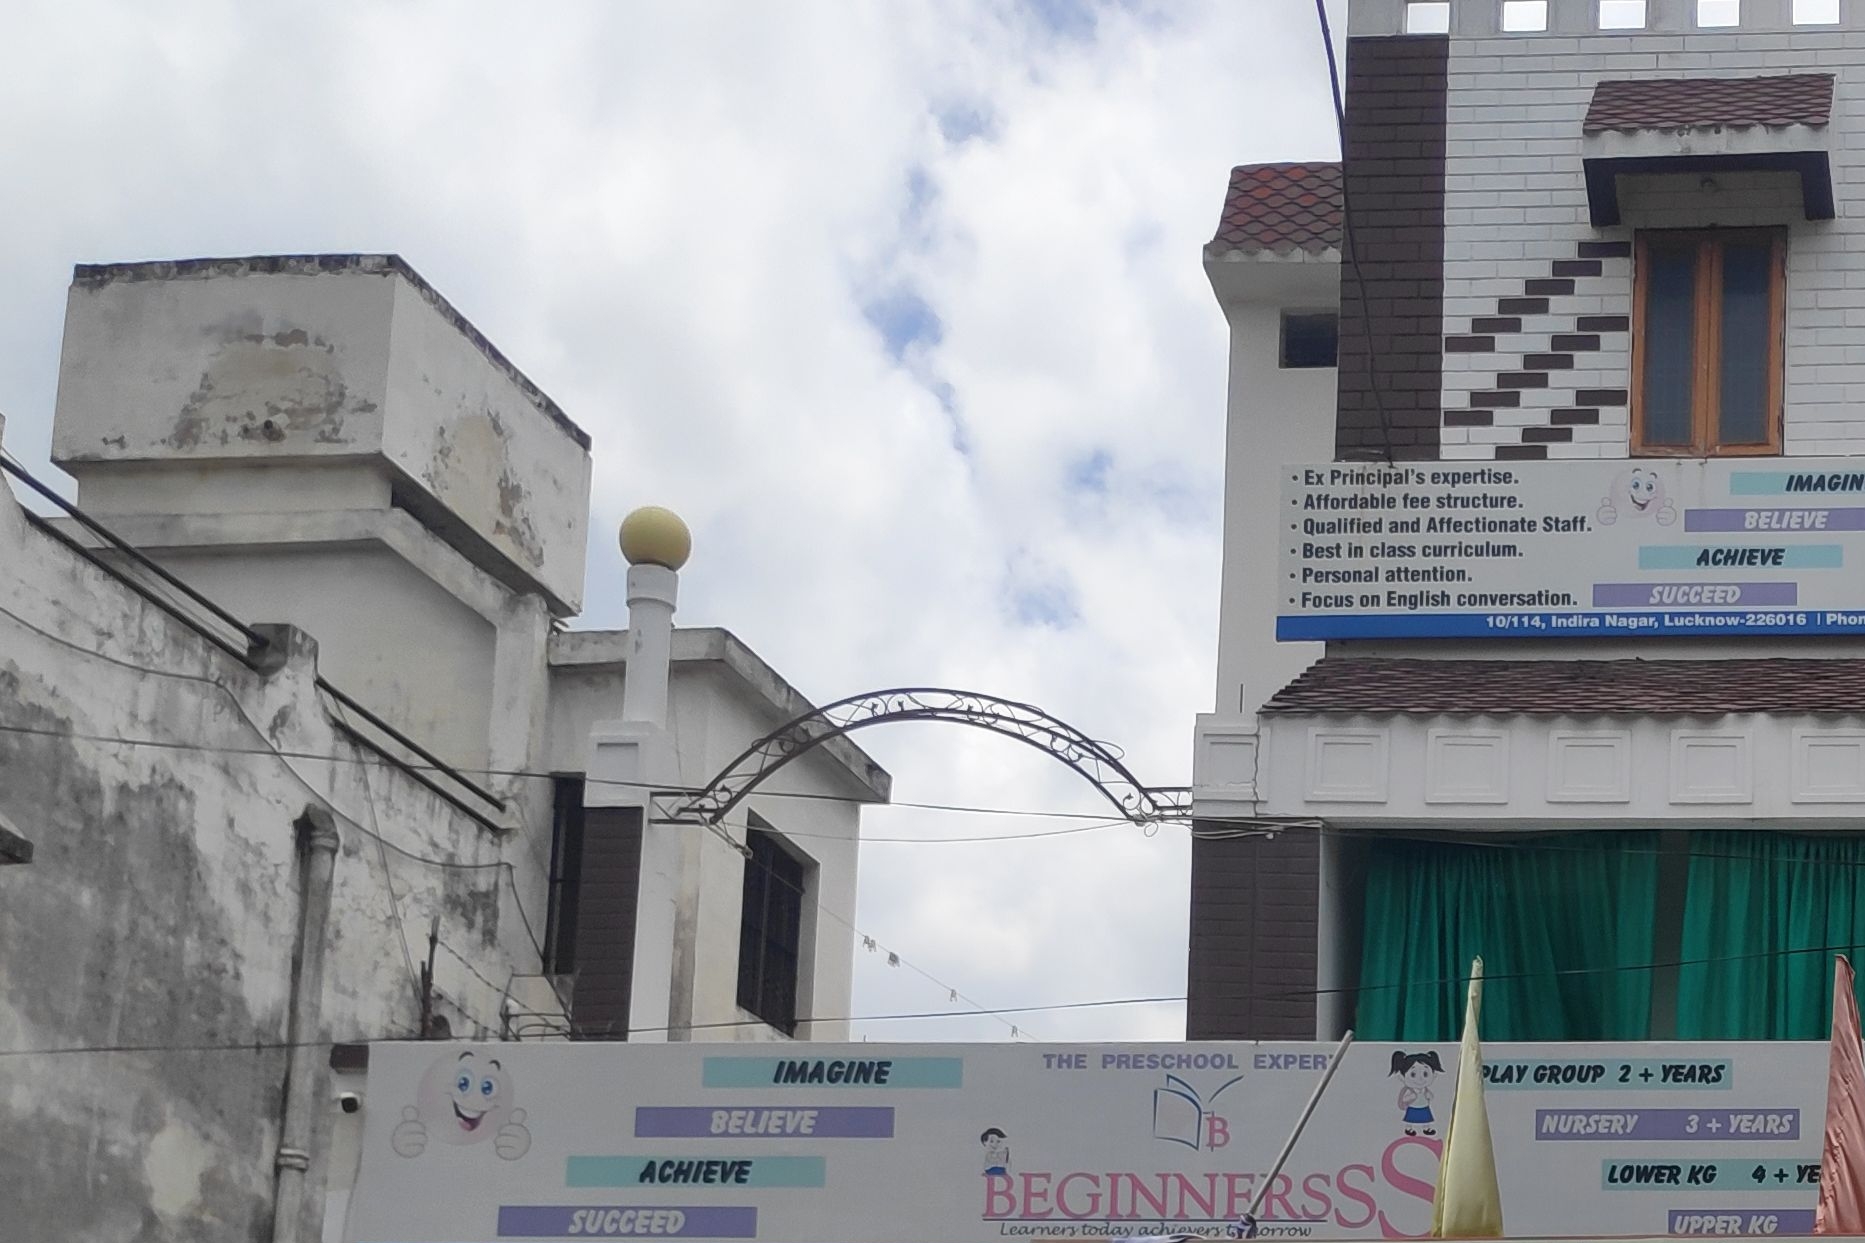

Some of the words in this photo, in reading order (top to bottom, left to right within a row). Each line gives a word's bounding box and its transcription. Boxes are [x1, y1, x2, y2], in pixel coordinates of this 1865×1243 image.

[1304, 470, 1323, 485] Ex
[1431, 470, 1519, 487] expertise.
[1304, 494, 1396, 510] Affordable
[1403, 494, 1430, 509] fee
[1436, 495, 1523, 509] structure.
[1304, 518, 1384, 535] Qualified
[1389, 518, 1420, 533] and
[1427, 517, 1536, 533] Affectionate
[1543, 516, 1591, 532] Staff.
[1745, 511, 1827, 529] BELIEVE
[1303, 543, 1342, 558] Best
[1370, 542, 1416, 558] class
[1422, 541, 1523, 557] curriculum.
[1697, 548, 1785, 566] ACHIEVE
[1303, 567, 1379, 583] Personal
[1385, 566, 1472, 582] attention.
[1302, 592, 1353, 608] Focus
[1387, 591, 1450, 609] English
[1457, 591, 1577, 606] conversation.
[1649, 586, 1741, 603] SUCCEED
[1487, 615, 1546, 629] 10/114,
[1552, 615, 1599, 628] Indira
[1605, 615, 1658, 629] Nagar,
[1664, 614, 1806, 627] Lucknow-226016
[1043, 1054, 1087, 1070] THE
[1101, 1054, 1238, 1069] PRESCHOOL
[773, 1060, 892, 1084] IMAGINE
[1533, 1065, 1605, 1084] GROUP
[1661, 1065, 1725, 1084] YEARS
[710, 1110, 818, 1135] BELIEVE
[1542, 1114, 1638, 1134] NURSERY
[1728, 1114, 1793, 1133] YEARS
[639, 1160, 752, 1184] ACHIEVE
[1608, 1165, 1680, 1184] LOWER
[1687, 1165, 1717, 1184] KG
[568, 1210, 685, 1234] SUCCEED
